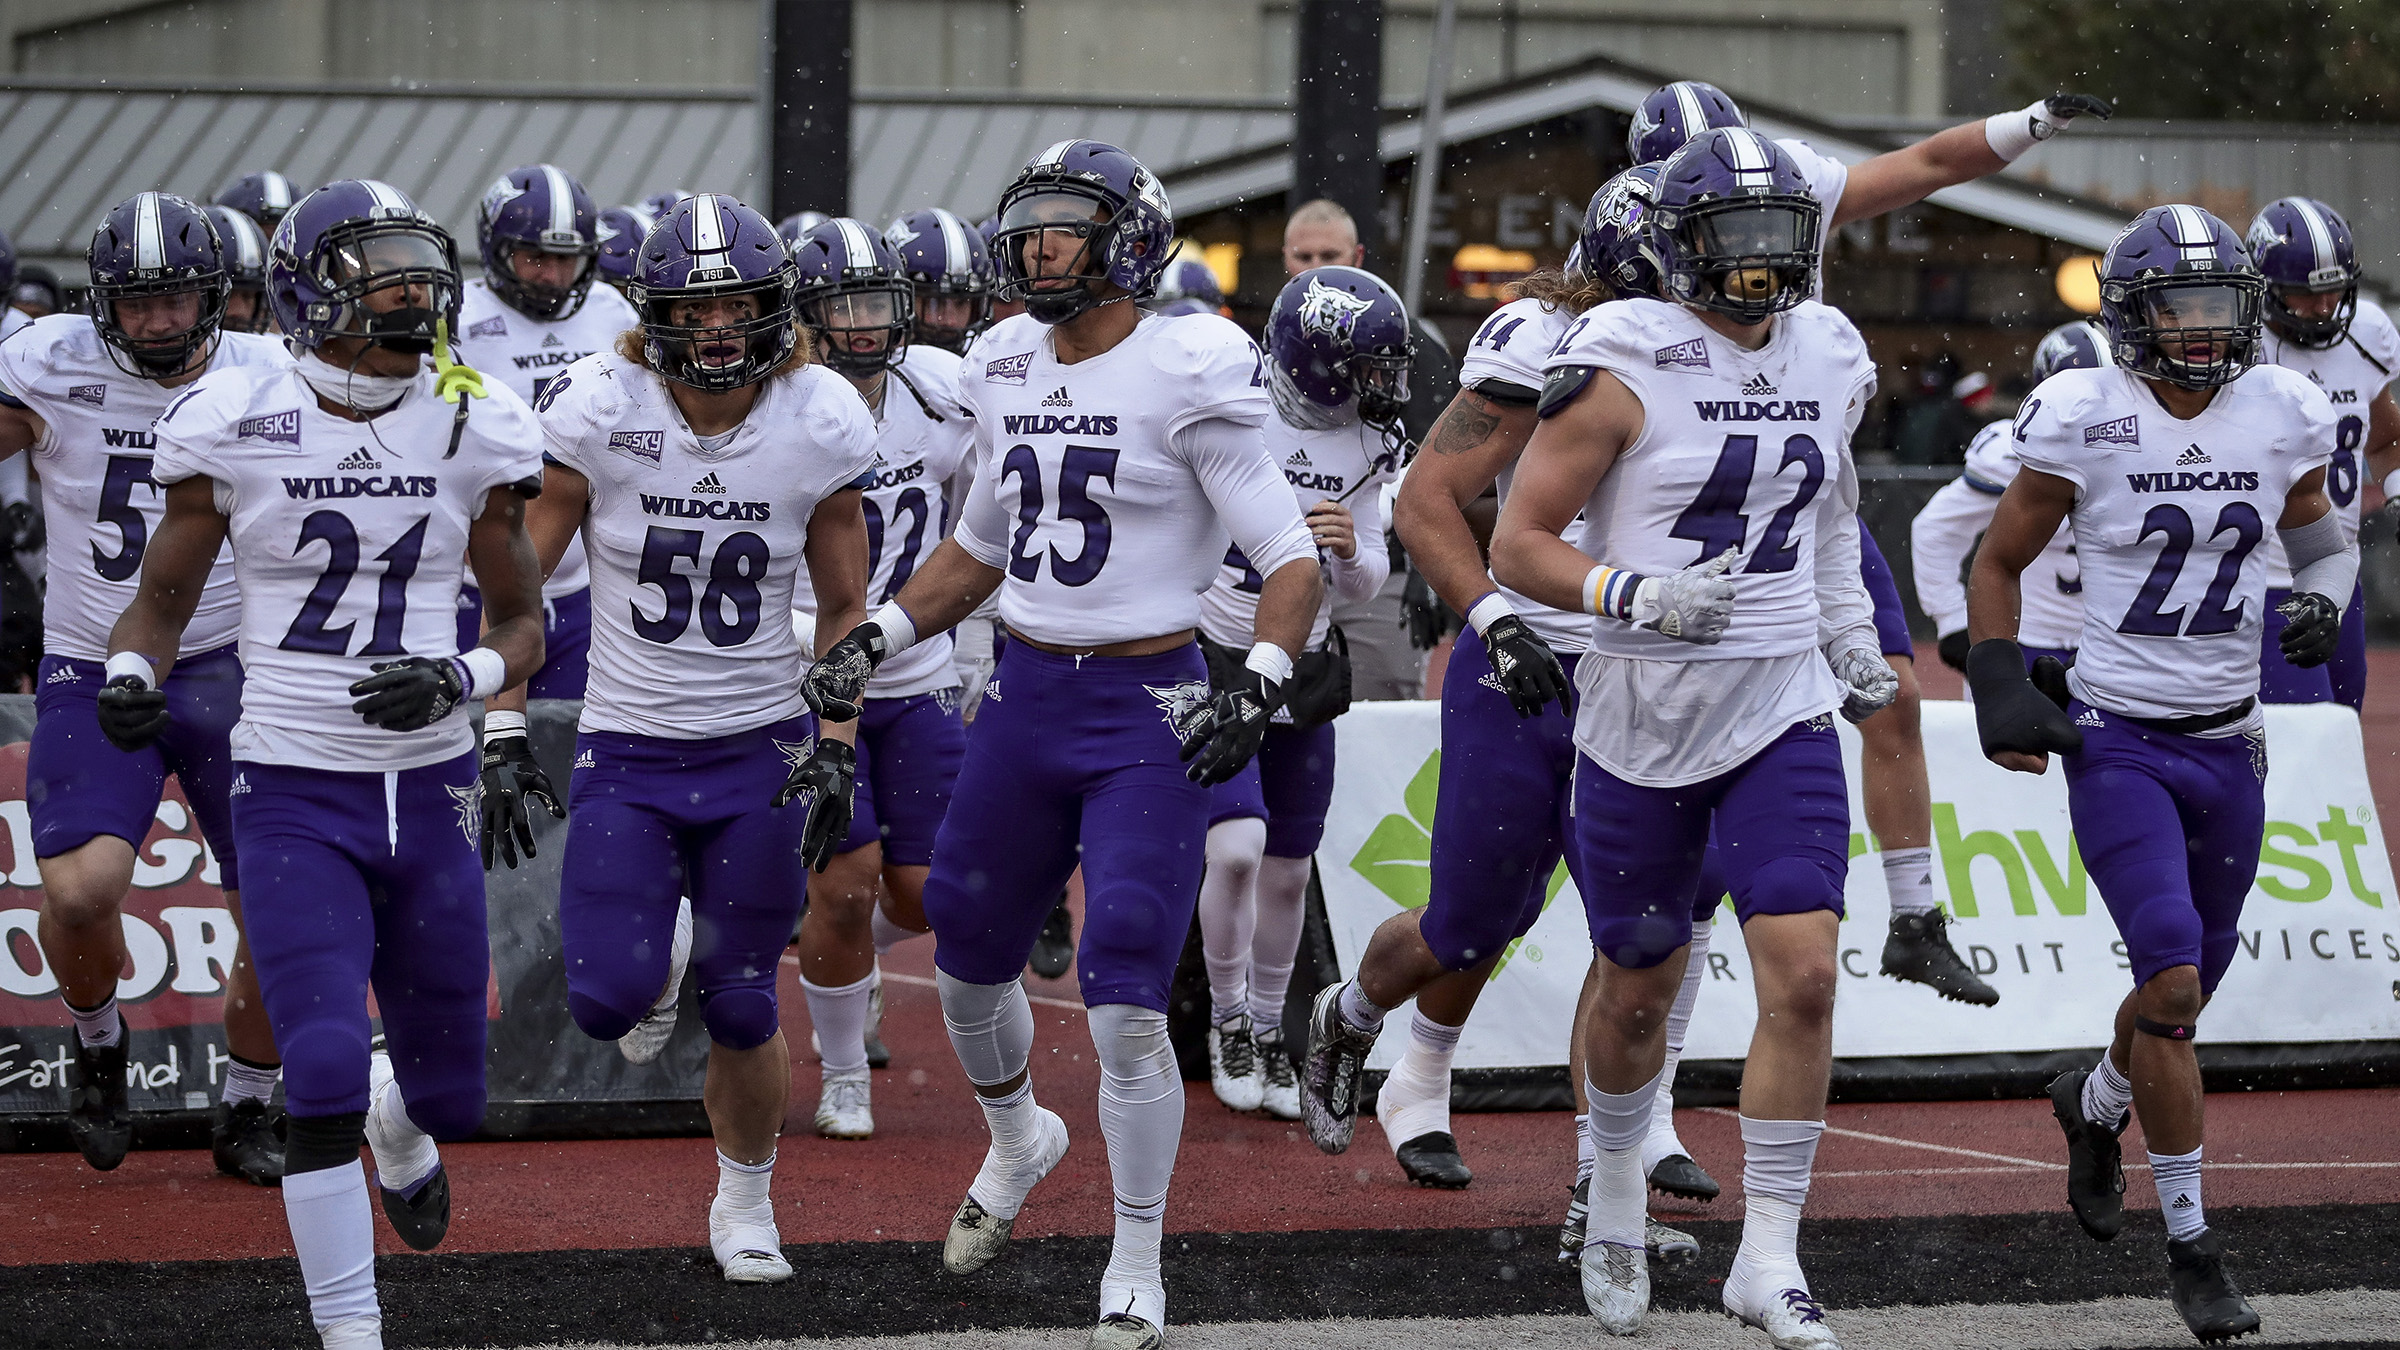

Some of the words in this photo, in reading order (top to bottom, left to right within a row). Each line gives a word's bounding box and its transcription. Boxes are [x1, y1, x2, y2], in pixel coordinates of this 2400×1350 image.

[1747, 187, 1769, 196] WSU
[391, 208, 412, 217] WSU
[138, 269, 160, 279] WSU
[701, 269, 724, 280] WSU
[854, 267, 874, 277] WSU
[2190, 261, 2212, 270] WSU
[1248, 341, 1270, 389] 2
[1041, 397, 1073, 407] adidas
[1742, 386, 1778, 396] adidas
[1694, 400, 1821, 422] WILDCATS
[1003, 414, 1118, 436] WILDCATS
[337, 458, 382, 470] adidas
[2176, 454, 2212, 466] adidas
[863, 460, 925, 491] DCATS
[1282, 469, 1344, 492] DCATS
[2126, 471, 2260, 493] WILDCATS
[281, 475, 437, 500] WILDCATS
[691, 484, 727, 494] adidas
[639, 493, 771, 522] WILDCATS
[1668, 433, 1825, 573] 42
[1000, 443, 1121, 588] 25
[2115, 501, 2264, 637] 22
[278, 510, 430, 657] 21
[629, 525, 771, 647] 58
[2075, 718, 2105, 728] adidas
[1841, 943, 2064, 978] CDIT
[2110, 927, 2400, 969] SVICES
